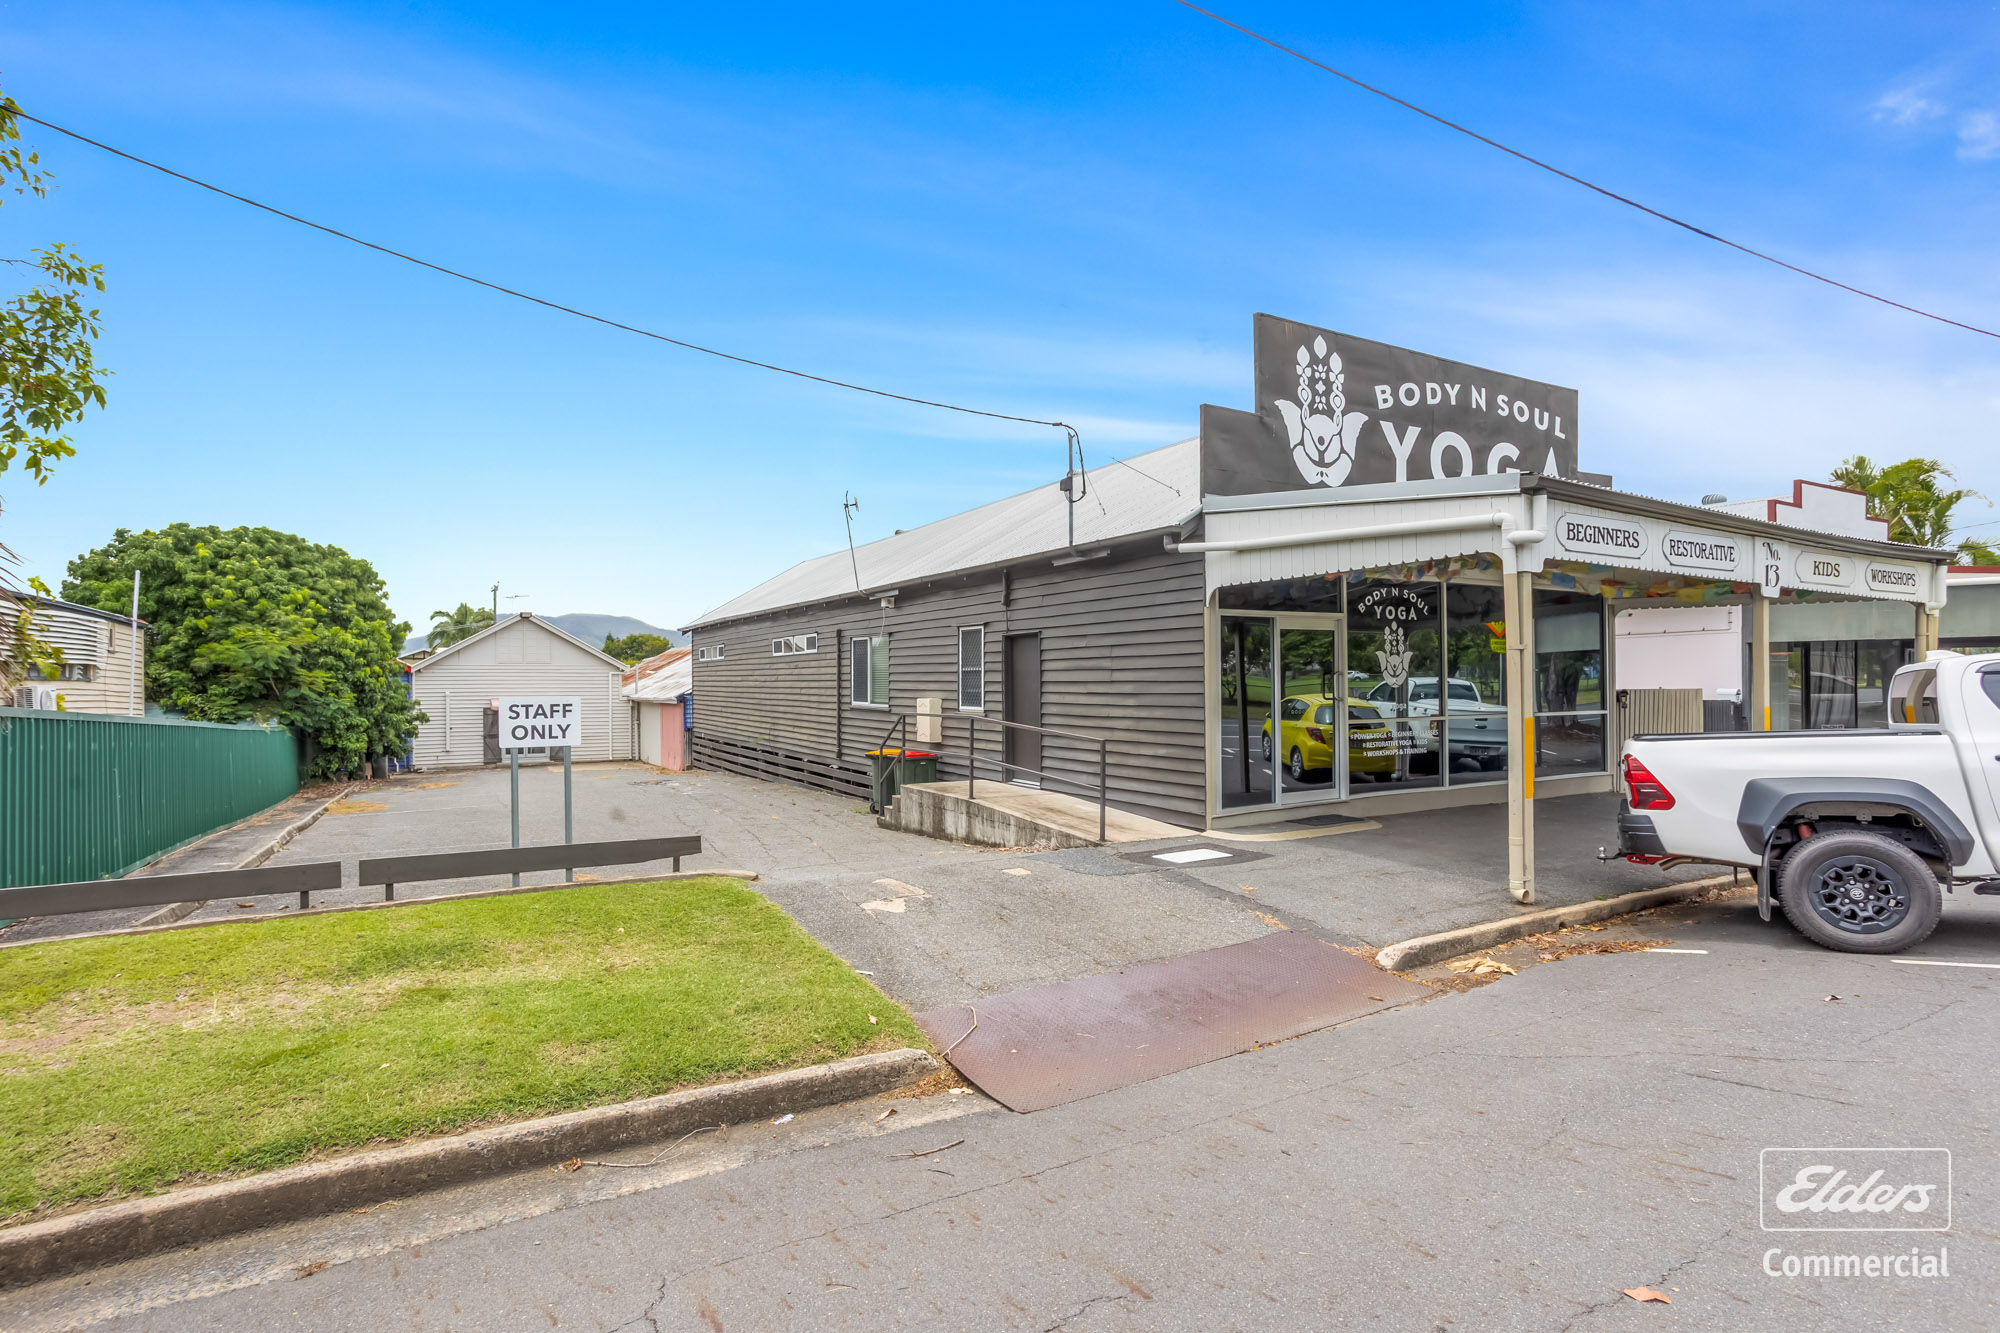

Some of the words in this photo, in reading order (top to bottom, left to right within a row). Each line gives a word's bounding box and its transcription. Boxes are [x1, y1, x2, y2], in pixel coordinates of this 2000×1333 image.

[1374, 382, 1461, 410] BODY
[1471, 384, 1487, 412] N
[1497, 394, 1566, 440] SOUL
[1566, 522, 1640, 549] BEGINNERS
[1668, 539, 1736, 563] RESTORATIVE
[1762, 541, 1781, 561] No.
[1764, 564, 1780, 588] 13
[1812, 560, 1841, 578] KIDS
[1870, 568, 1916, 588] WORKSHOPS
[1358, 587, 1387, 614] BODY
[1391, 587, 1399, 597] N
[1403, 589, 1429, 615] SOUL
[1374, 605, 1417, 621] YOGA
[508, 703, 573, 720] STAFF
[510, 723, 571, 741] ONLY
